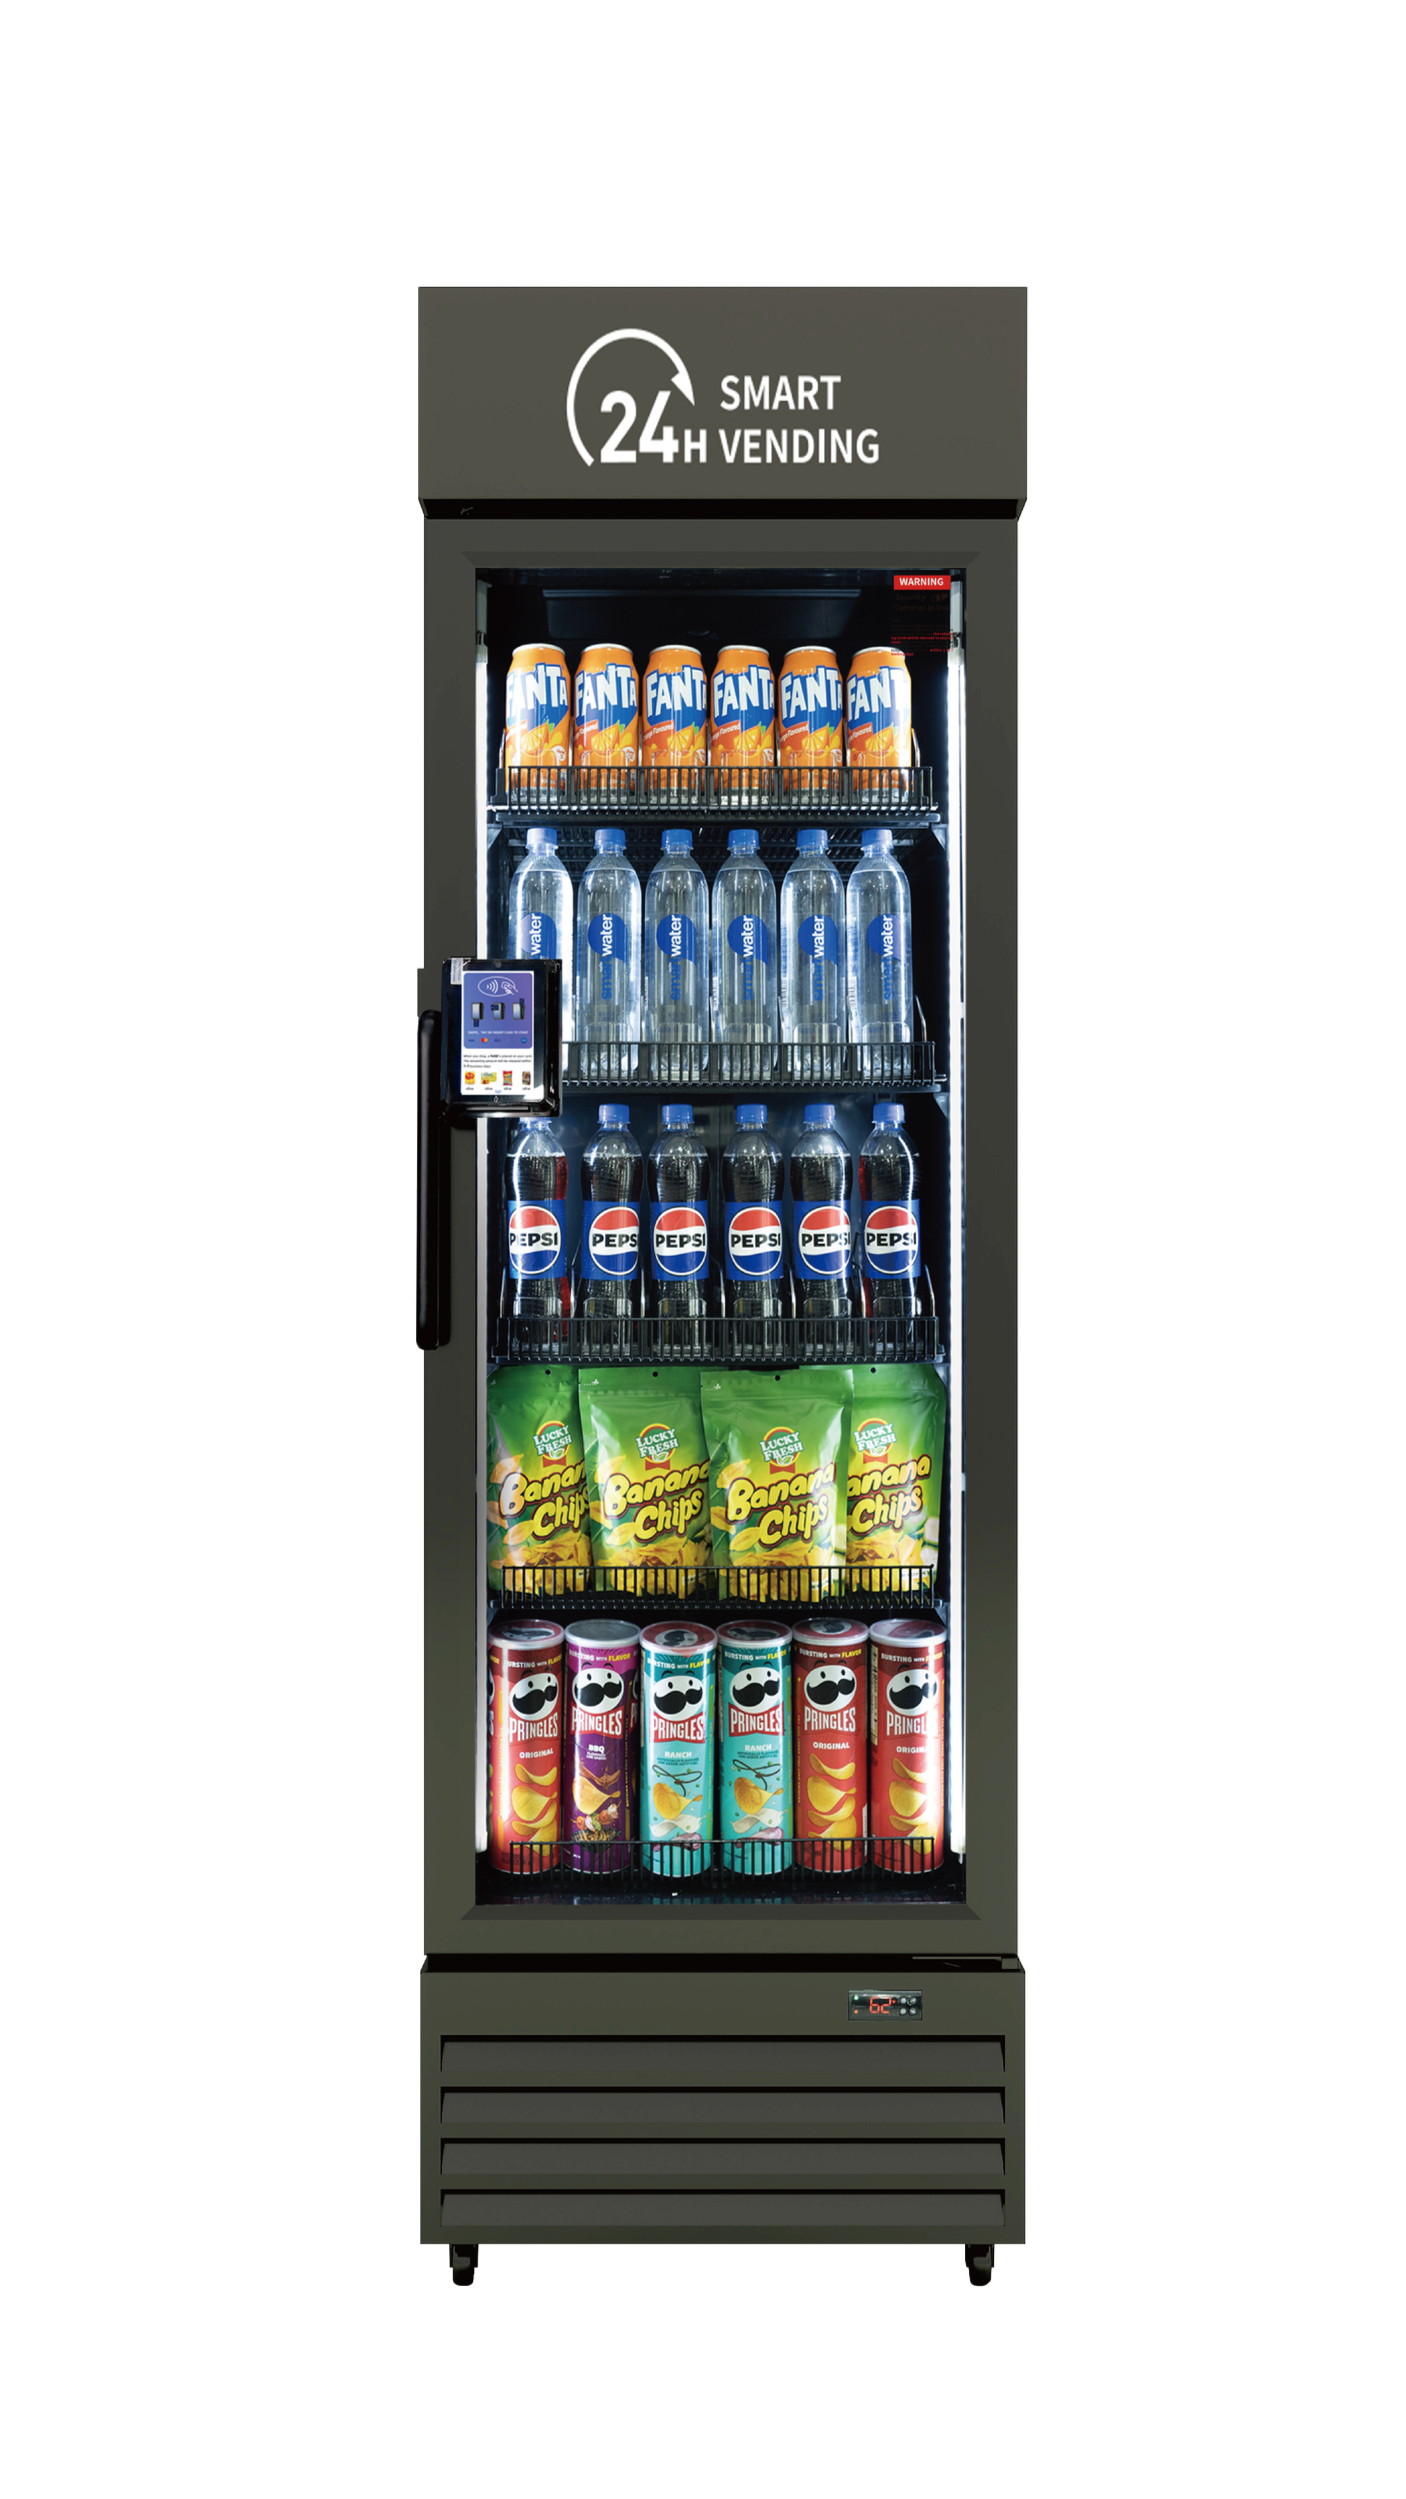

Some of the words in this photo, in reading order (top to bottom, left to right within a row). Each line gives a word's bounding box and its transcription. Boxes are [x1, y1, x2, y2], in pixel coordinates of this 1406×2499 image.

[720, 374, 842, 412] SMART
[718, 427, 881, 465] VENDING
[899, 577, 944, 586] WARNING
[575, 664, 638, 719] FANTA
[847, 668, 908, 722] FANT
[510, 1232, 558, 1247] PEPSI
[592, 1233, 638, 1248] PEPS
[655, 1232, 706, 1248] PEPSI
[731, 1233, 781, 1248] PEPSI
[866, 1231, 917, 1247] PEPSI
[533, 1425, 569, 1444] LUCKY
[635, 1427, 677, 1447] LUCKY
[759, 1431, 800, 1452] LUCKY
[853, 1423, 894, 1442] LUCKY
[857, 1432, 897, 1452] FRESH
[536, 1434, 573, 1456] FRESH
[639, 1437, 679, 1459] FRESH
[763, 1441, 804, 1463] FRESH
[847, 1455, 932, 1498] anana
[726, 1462, 836, 1522] Banana
[634, 1490, 704, 1541] Chips
[758, 1495, 828, 1546] Chips
[850, 1487, 923, 1535] Chips
[608, 1652, 631, 1662] FLAVOR
[724, 1651, 754, 1661] BURSTING
[799, 1647, 828, 1659] BURSTING
[841, 1649, 862, 1659] FLAVOR
[881, 1652, 912, 1663] BURSTING
[508, 1661, 536, 1669] URSTING
[509, 1712, 558, 1742] PRINGLES
[571, 1705, 623, 1736] PRINGLES
[653, 1714, 705, 1741] PRINGLES
[730, 1707, 781, 1733] PRINGLES
[804, 1705, 856, 1732] PRINGLES
[886, 1710, 928, 1736] PRINGL
[519, 1748, 554, 1759] ORIGINAL
[588, 1744, 605, 1754] BBQ
[744, 1744, 772, 1752] RANCH
[812, 1741, 850, 1750] ORIGINAL
[869, 1996, 892, 2014] 62
